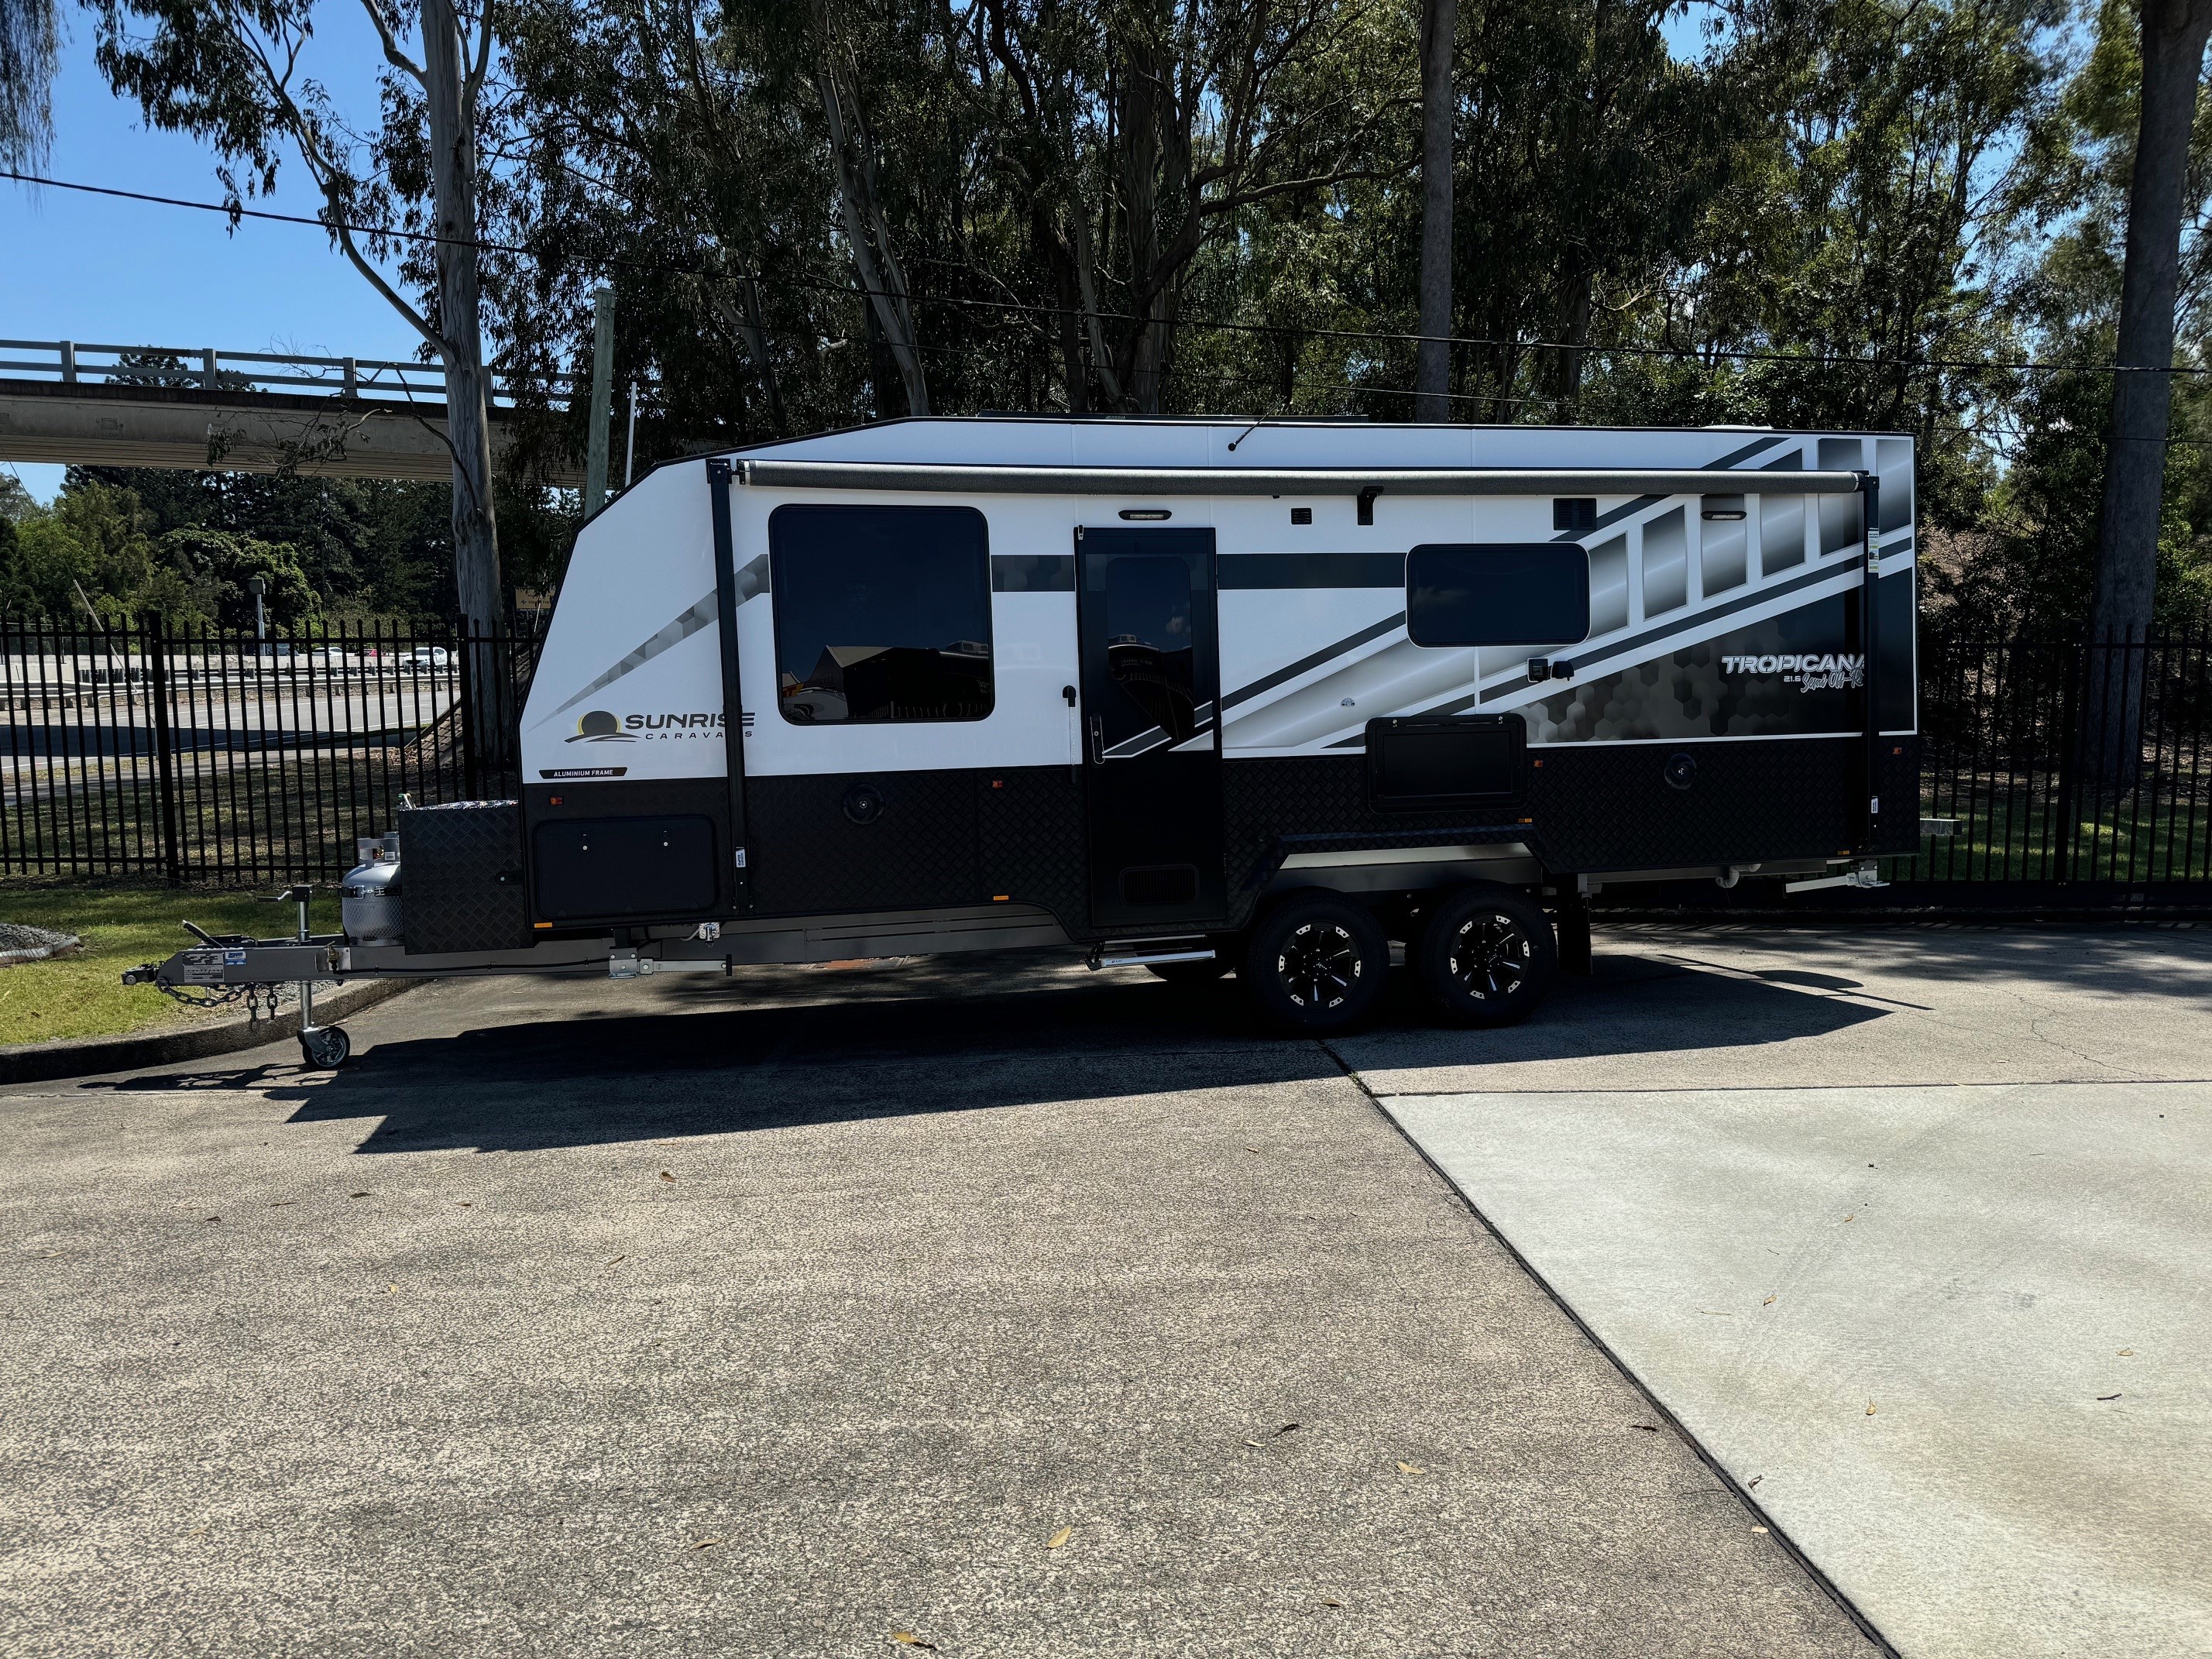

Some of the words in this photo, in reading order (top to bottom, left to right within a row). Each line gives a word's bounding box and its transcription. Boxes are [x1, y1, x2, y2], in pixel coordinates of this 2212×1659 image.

[1801, 672, 1828, 693] Semi
[1828, 668, 1864, 689] Off-R
[645, 731, 753, 740] CARAVAS
